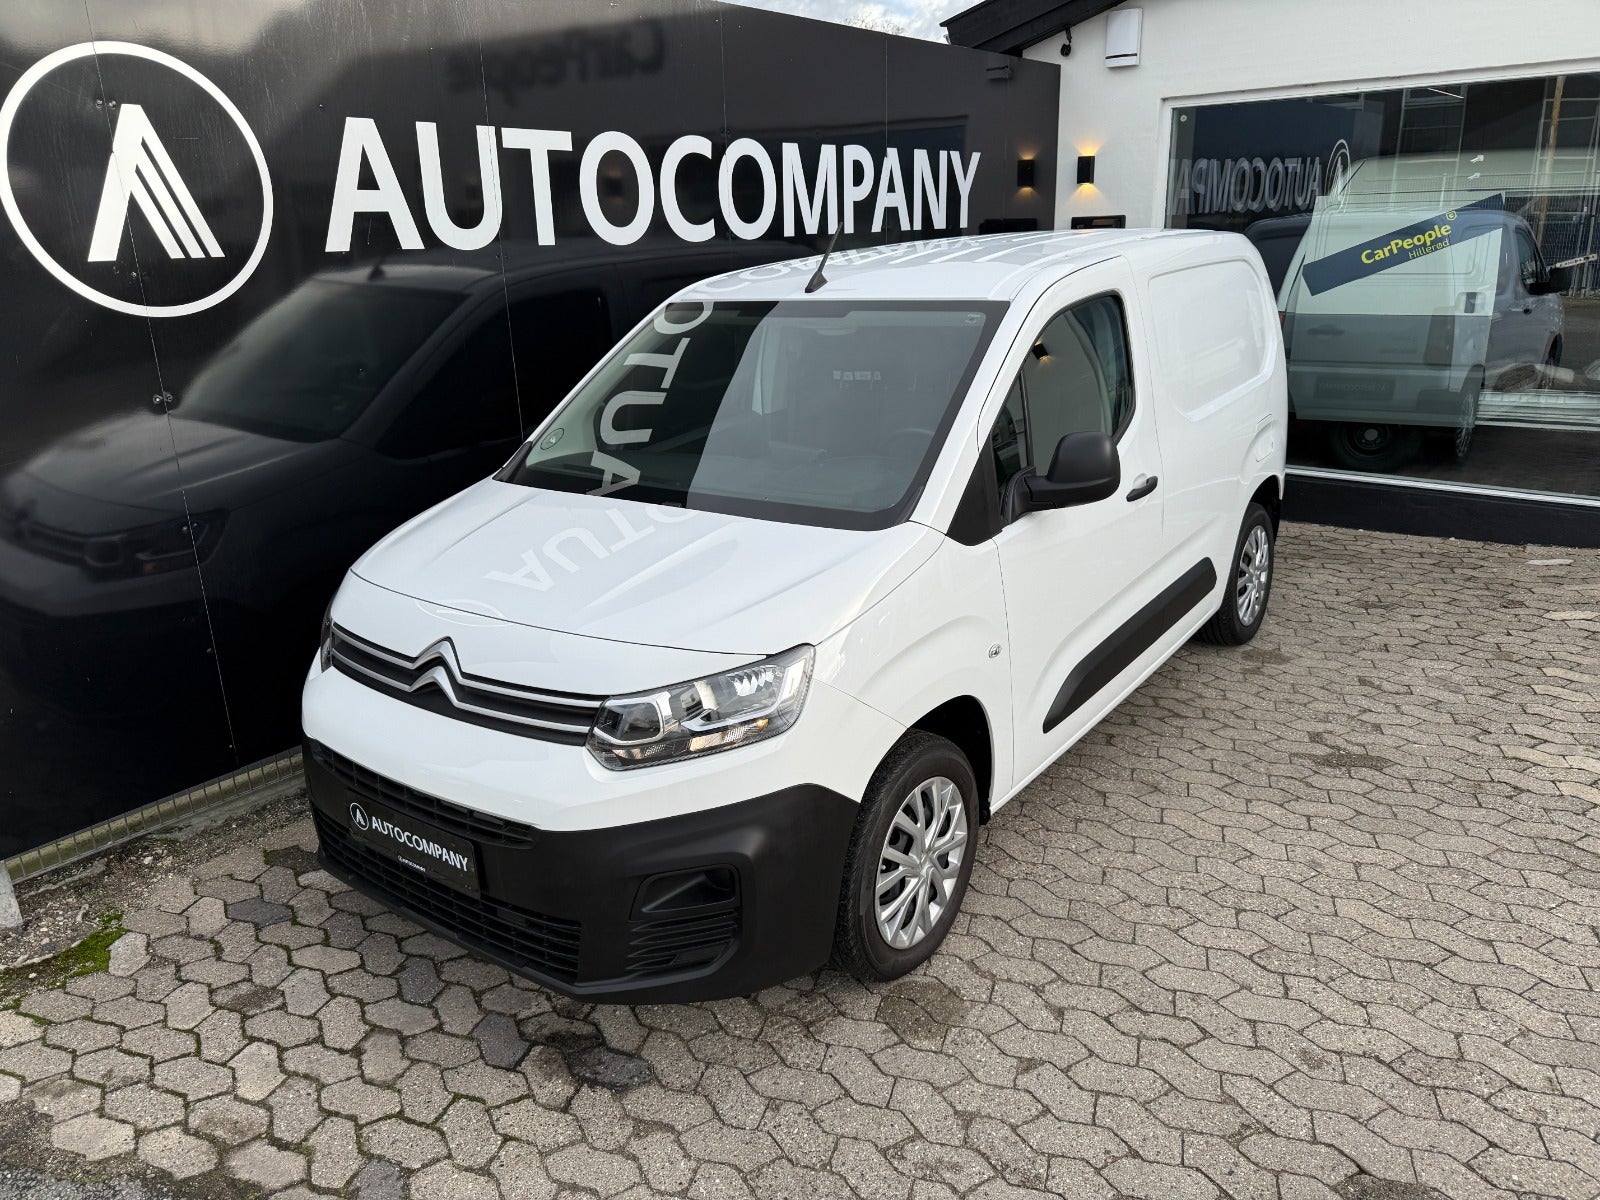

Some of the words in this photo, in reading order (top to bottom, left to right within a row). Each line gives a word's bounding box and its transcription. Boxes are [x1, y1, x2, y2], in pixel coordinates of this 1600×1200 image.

[325, 116, 981, 252] AUTOCOMPANY
[1361, 224, 1451, 264] CarPeople
[1408, 238, 1450, 259] Hillerød
[371, 816, 468, 872] AUTOCOMPANY
